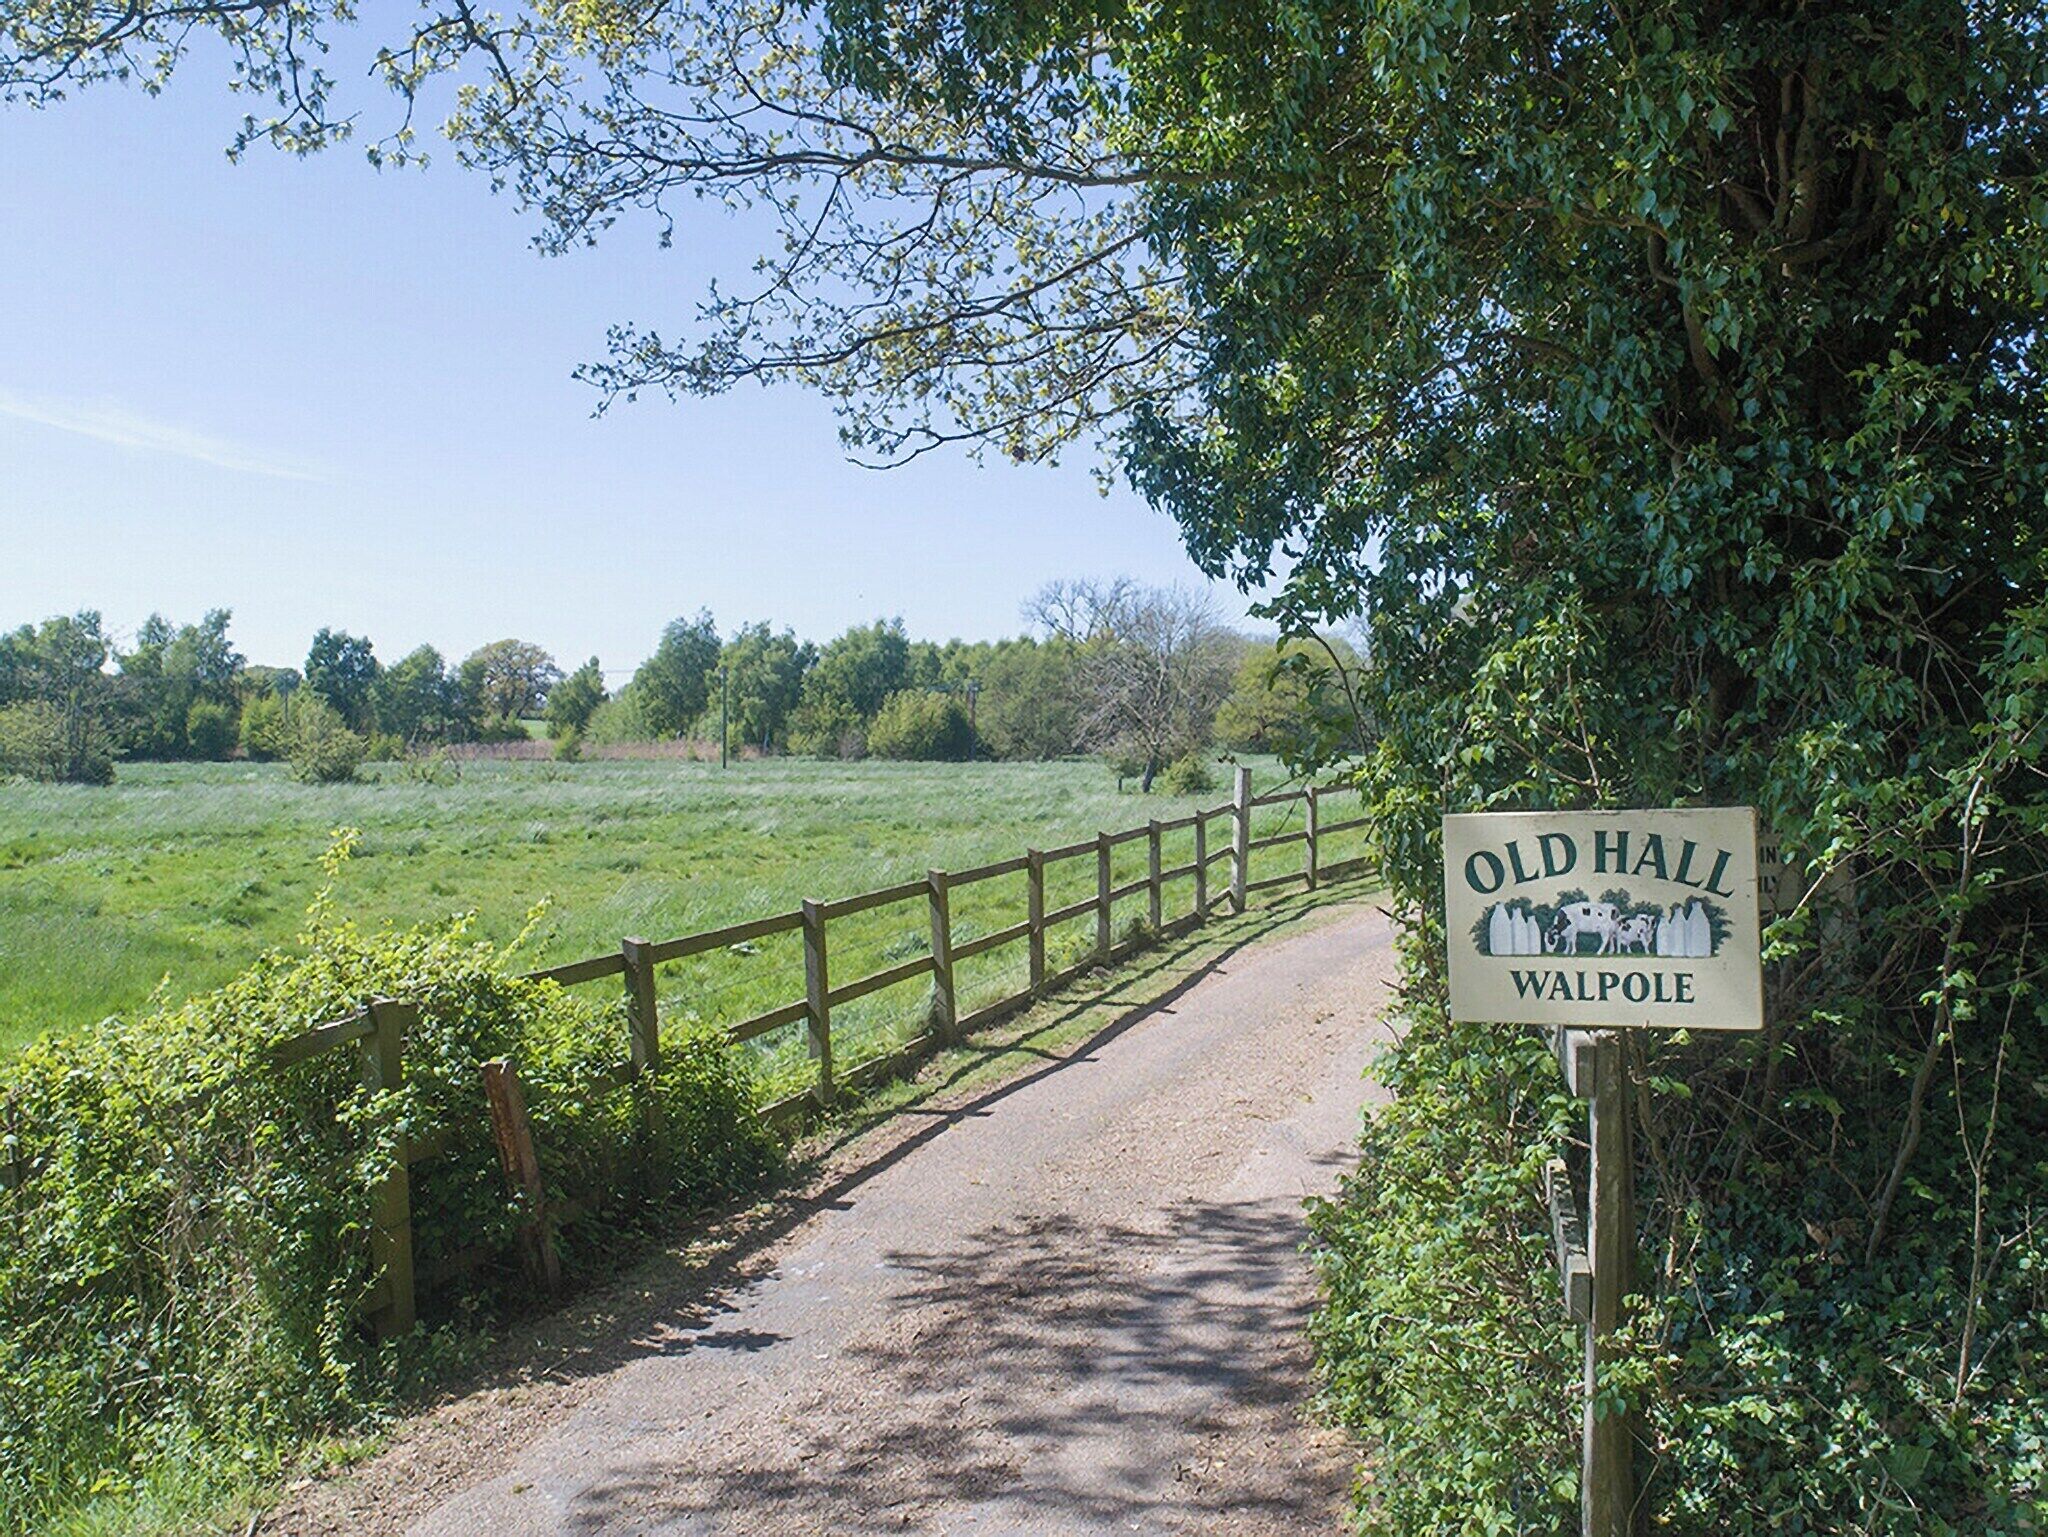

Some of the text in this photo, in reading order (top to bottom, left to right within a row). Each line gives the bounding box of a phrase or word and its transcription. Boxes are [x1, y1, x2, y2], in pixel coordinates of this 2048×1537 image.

[1464, 830, 1735, 898] OLD HALL
[1510, 970, 1695, 1003] WALPOLE
